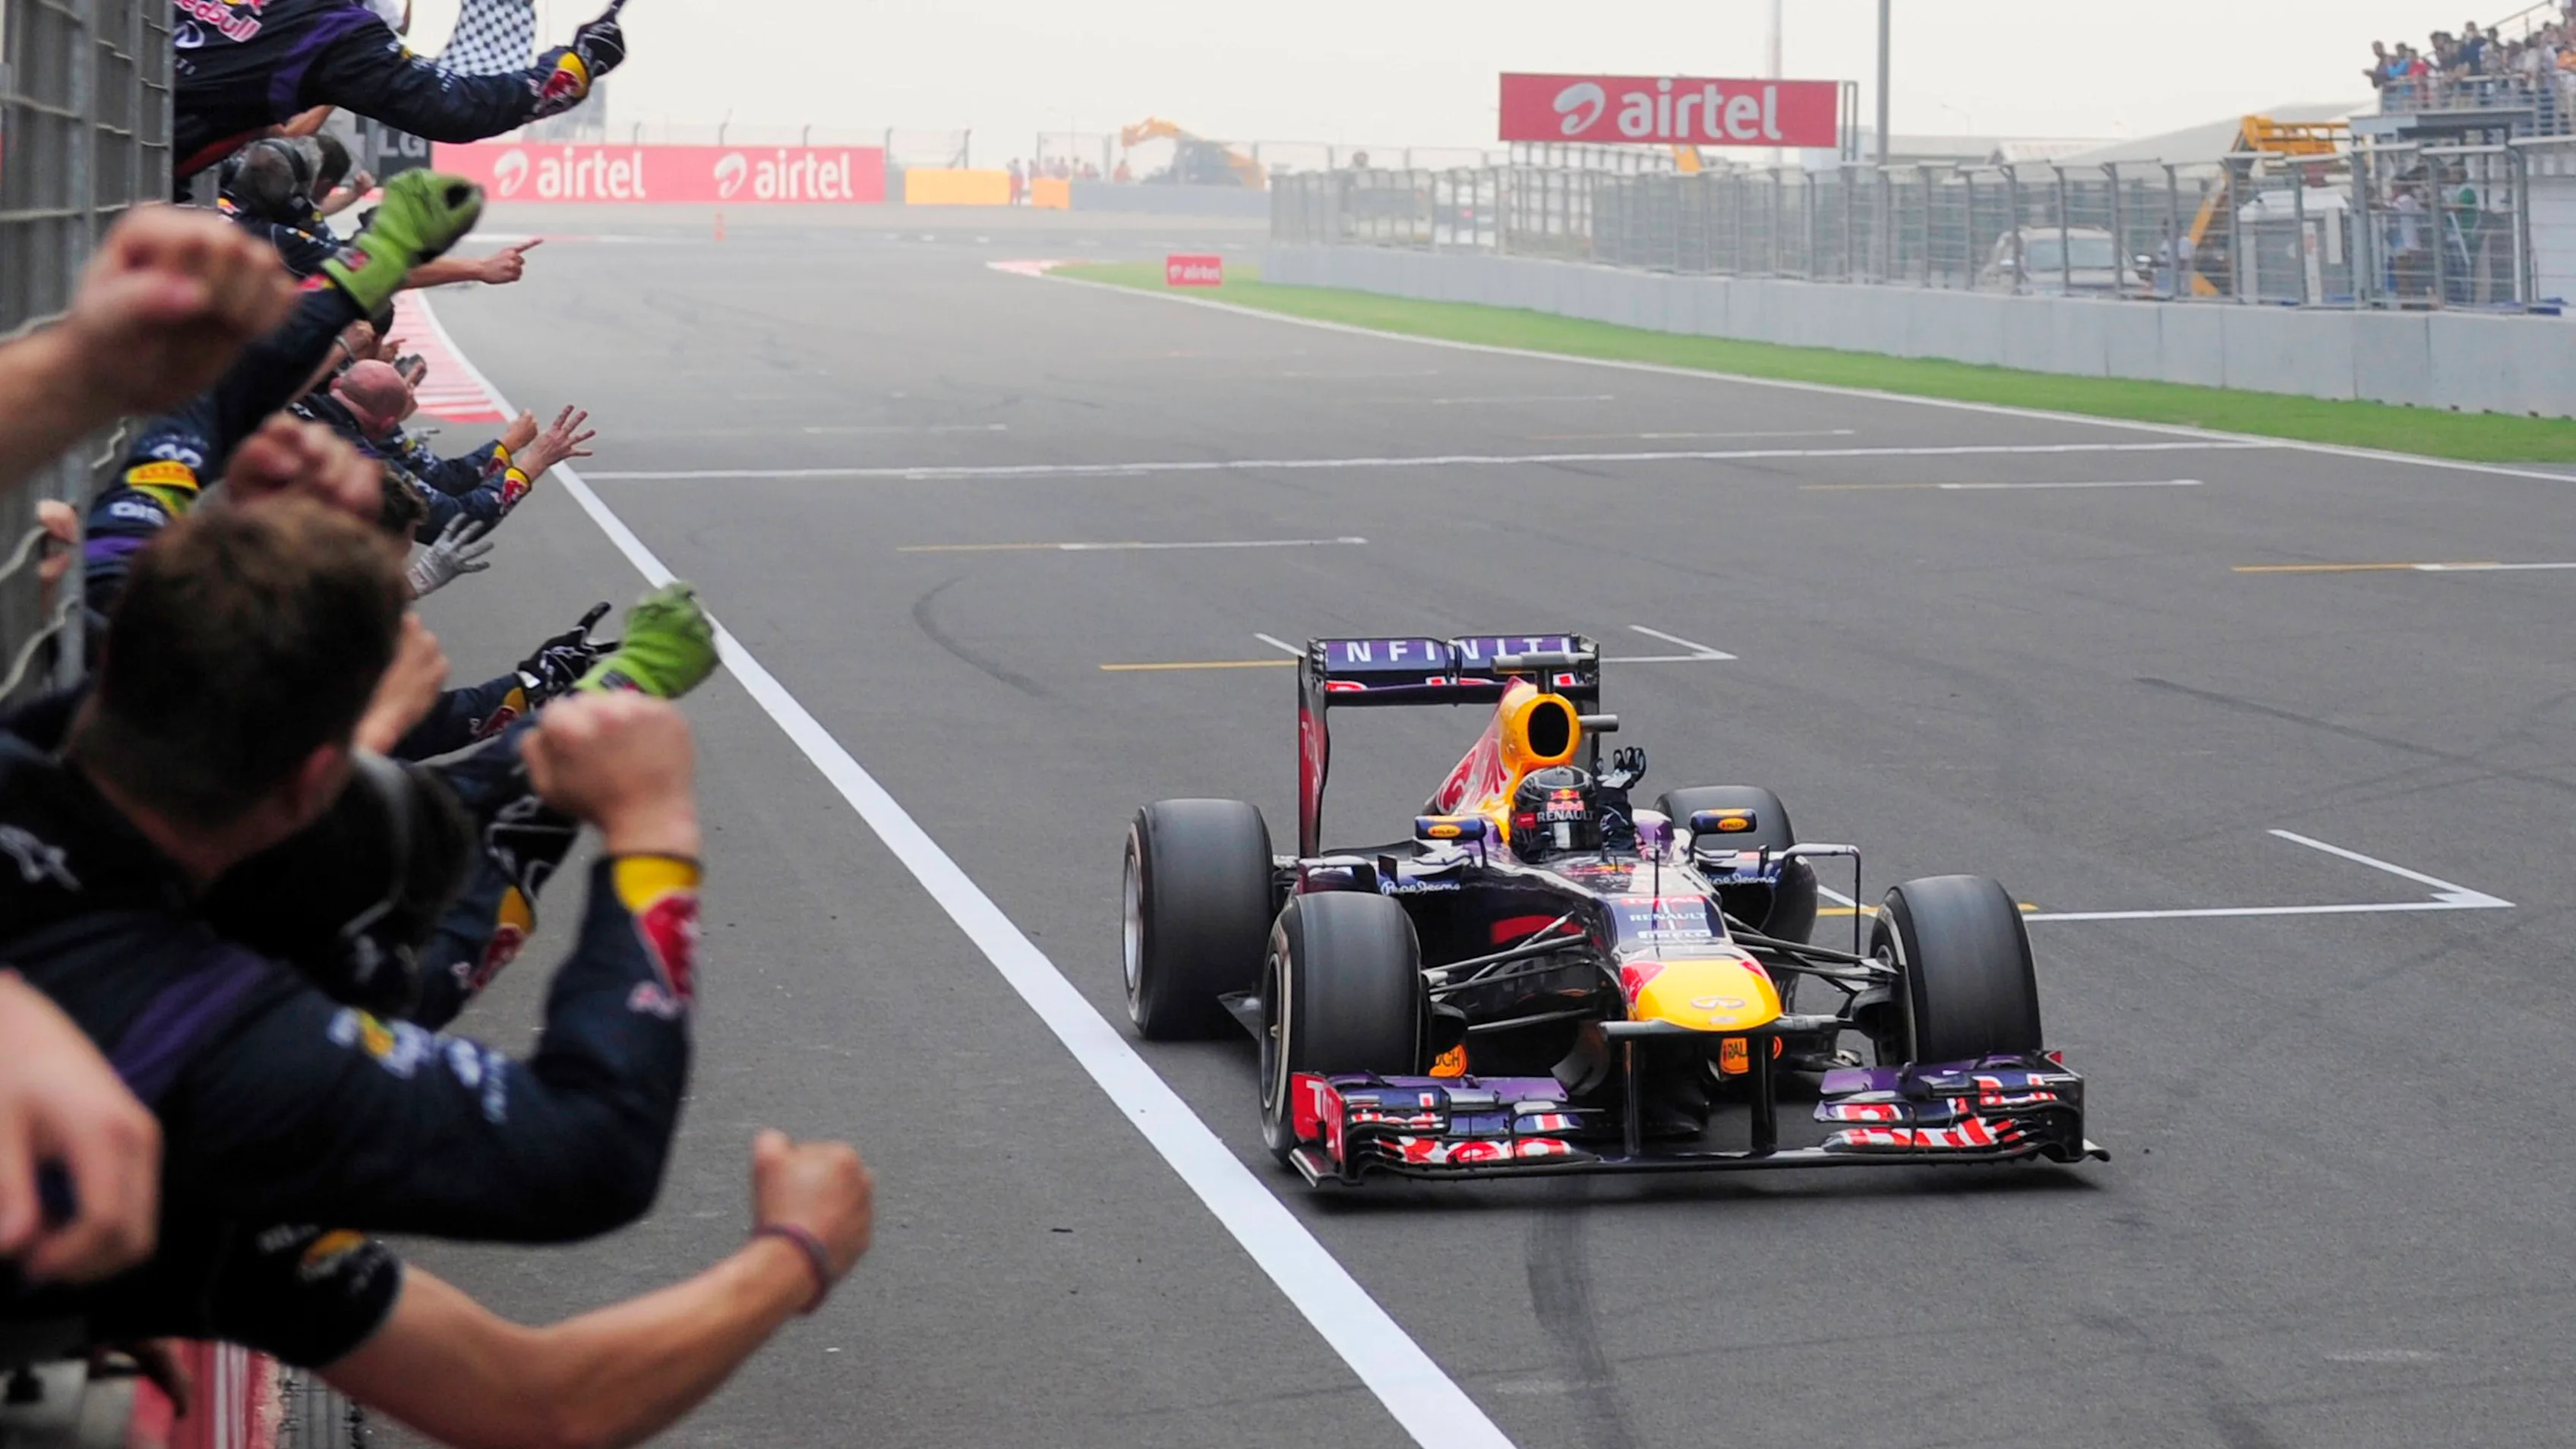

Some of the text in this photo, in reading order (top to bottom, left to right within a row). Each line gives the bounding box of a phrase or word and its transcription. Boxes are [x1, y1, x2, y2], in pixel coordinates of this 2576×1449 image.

[1618, 77, 1782, 140] airtel
[378, 127, 427, 158] LG
[537, 146, 646, 198] airtel
[754, 148, 853, 200] airtel
[1324, 636, 1571, 662] NFINITI
[1536, 810, 1594, 822] RENAULT
